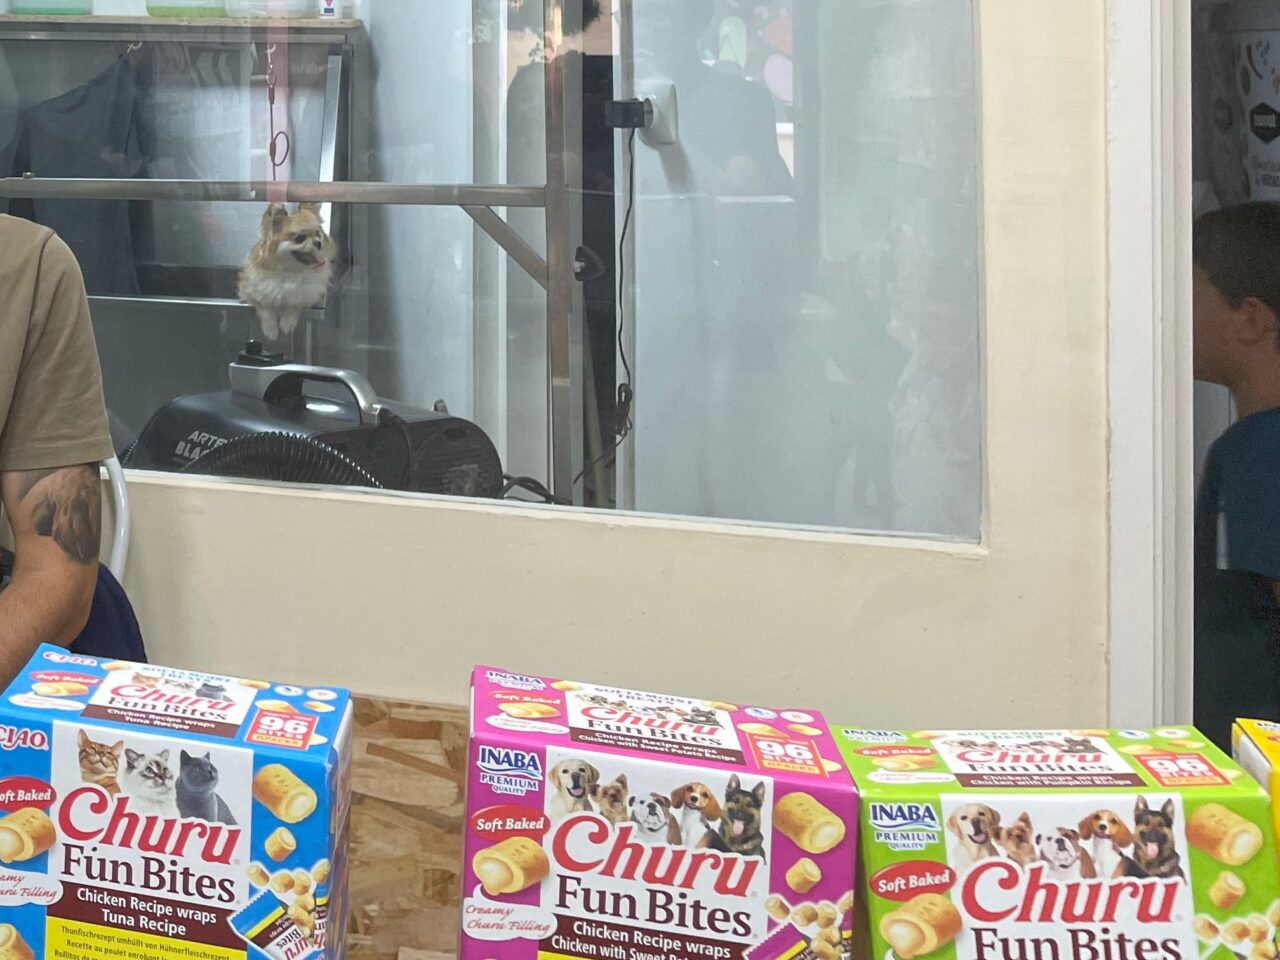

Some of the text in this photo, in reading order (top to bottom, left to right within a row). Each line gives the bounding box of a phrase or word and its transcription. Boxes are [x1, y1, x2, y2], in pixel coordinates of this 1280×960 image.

[489, 671, 543, 685] INABA
[110, 684, 236, 711] Churu
[494, 693, 560, 705] Soft Baked
[107, 708, 216, 729] Chicken Recipe wraps
[108, 697, 228, 720] Fun Bites
[125, 716, 190, 730] Tuna Recipe
[258, 716, 309, 734] 96
[581, 706, 720, 736] Churu
[588, 720, 722, 746] Fun Bites
[578, 735, 737, 762] Chicken with Sweet Potato Recipe
[595, 732, 718, 755] Chicken Recipe wraps
[756, 740, 814, 760] 96
[479, 747, 539, 772] INABA
[956, 750, 1102, 763] Churu
[1146, 758, 1209, 772] 96
[968, 763, 1113, 772] Fun Bites
[480, 773, 538, 791] PREMIUM
[492, 784, 526, 796] QUALITY
[17, 788, 51, 802] Baked
[476, 815, 544, 832] Soft Baked
[871, 804, 937, 823] INABA
[58, 786, 242, 865] Churu
[875, 831, 937, 843] PREMIUM
[889, 841, 925, 850] QUALITY
[552, 814, 759, 898] Churu
[61, 843, 235, 903] Fun Bites
[878, 870, 951, 892] Soft Baked
[20, 887, 57, 903] Filling
[961, 861, 1178, 924] Churu
[77, 888, 217, 925] Chicken Recipe wraps
[465, 904, 514, 921] Creamy
[555, 873, 752, 938] Fun Bites
[102, 909, 187, 936] Tuna Recipe
[466, 919, 551, 937] Churu Filling
[66, 939, 127, 958] Recette au poulet
[145, 941, 158, 950] von
[276, 928, 301, 949] Bites
[551, 935, 597, 955] Chicken
[599, 944, 626, 959] with
[573, 920, 731, 960] Chicken Recipe wraps
[973, 928, 1182, 960] Fun Bites
